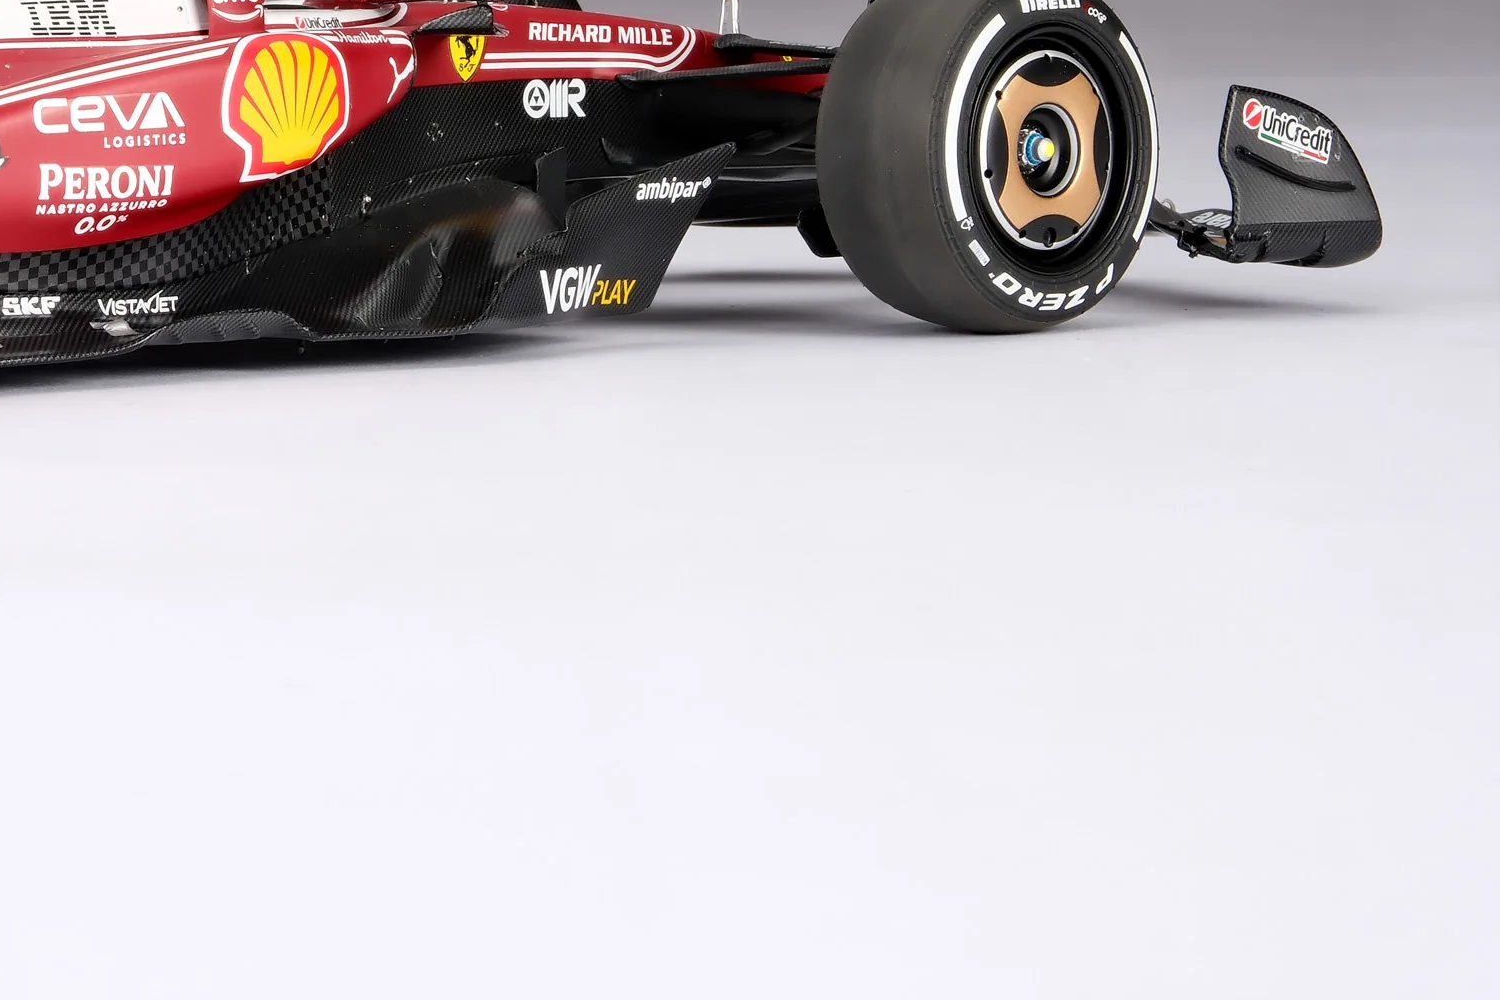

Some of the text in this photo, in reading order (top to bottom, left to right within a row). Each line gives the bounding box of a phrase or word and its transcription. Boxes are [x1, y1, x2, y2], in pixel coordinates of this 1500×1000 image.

[304, 16, 342, 29] UniCredit
[335, 30, 388, 45] Hamilton
[528, 22, 673, 47] RICHARD MILLE
[103, 133, 187, 149] LOGISTICS
[1262, 106, 1331, 155] UniCredit
[37, 163, 175, 201] PERONI
[636, 176, 702, 203] ambipar
[35, 199, 168, 215] NASTRO AZZURRO
[992, 262, 1114, 311] P ZERO
[1, 296, 61, 316] SKF
